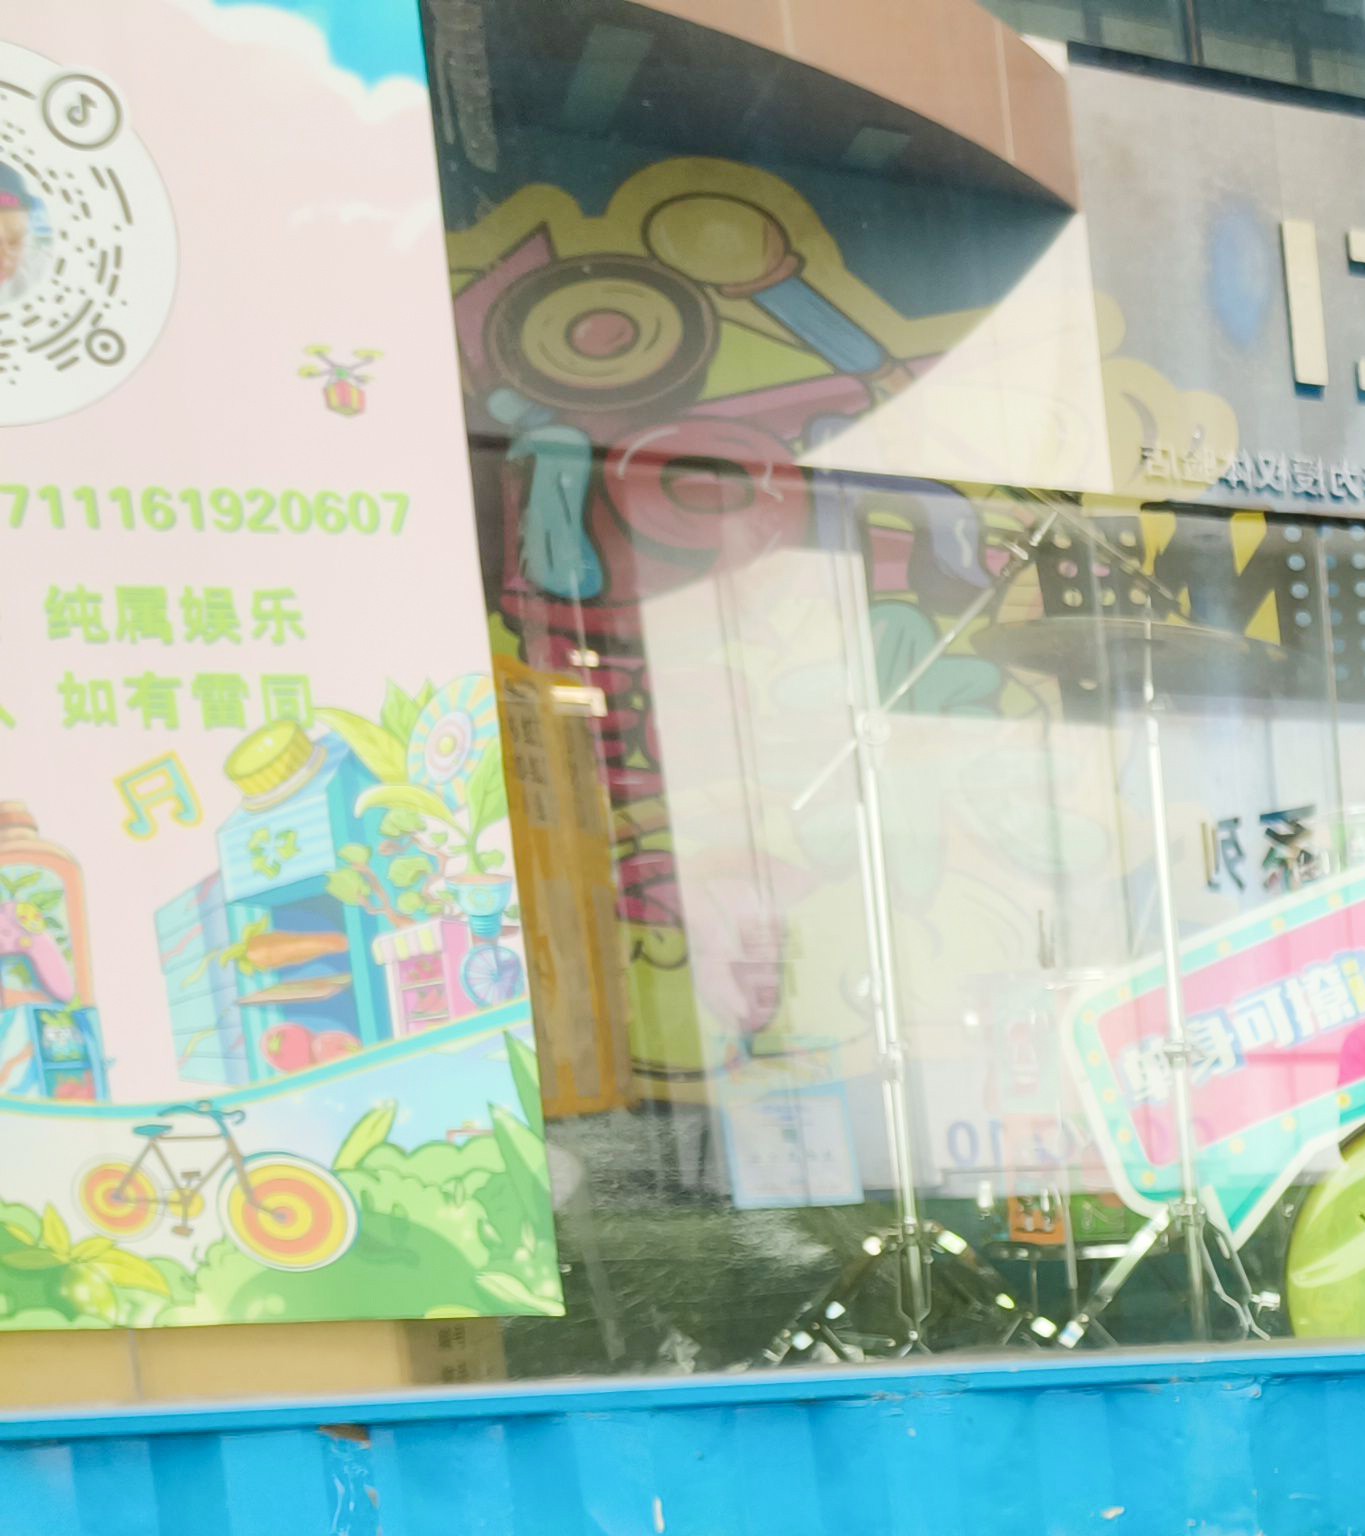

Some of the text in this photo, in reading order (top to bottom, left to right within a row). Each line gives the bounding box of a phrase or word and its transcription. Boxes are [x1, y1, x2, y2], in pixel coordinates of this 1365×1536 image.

[44, 584, 306, 645] 纯属娱乐
[57, 671, 315, 731] 如有雷同
